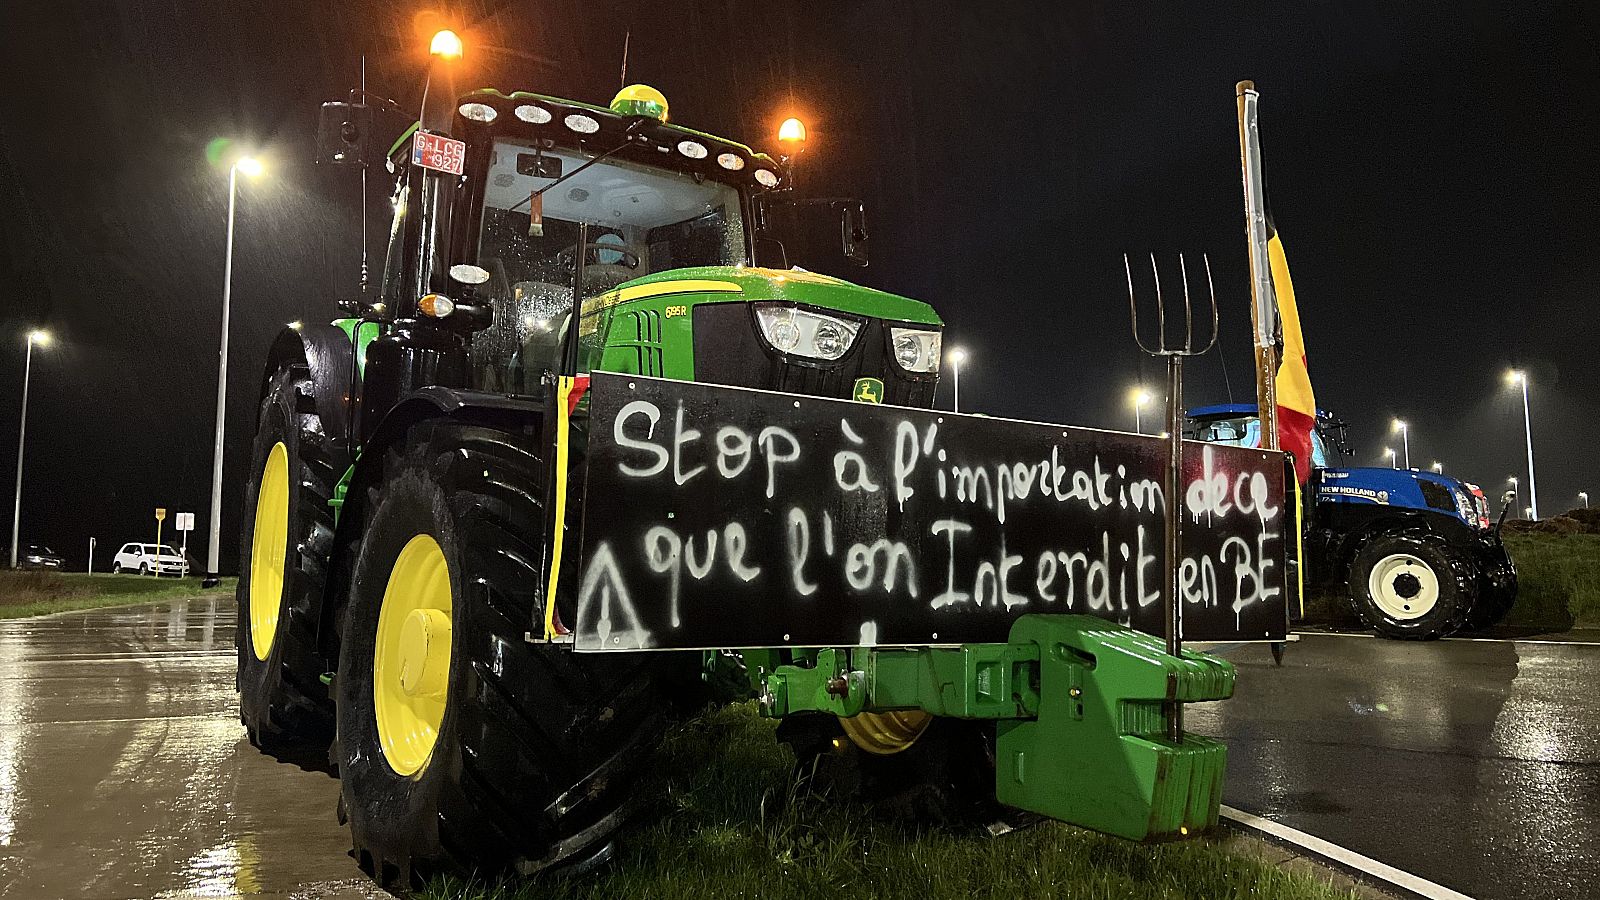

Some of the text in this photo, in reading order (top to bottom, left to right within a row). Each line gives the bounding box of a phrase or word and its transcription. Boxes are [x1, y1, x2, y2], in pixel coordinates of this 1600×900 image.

[614, 399, 801, 498] Stop
[833, 418, 880, 492] à
[894, 420, 1167, 524] l'importation
[1321, 486, 1377, 497] NEW HOLLAND
[644, 506, 1280, 628] que l'on Interdit en BE
